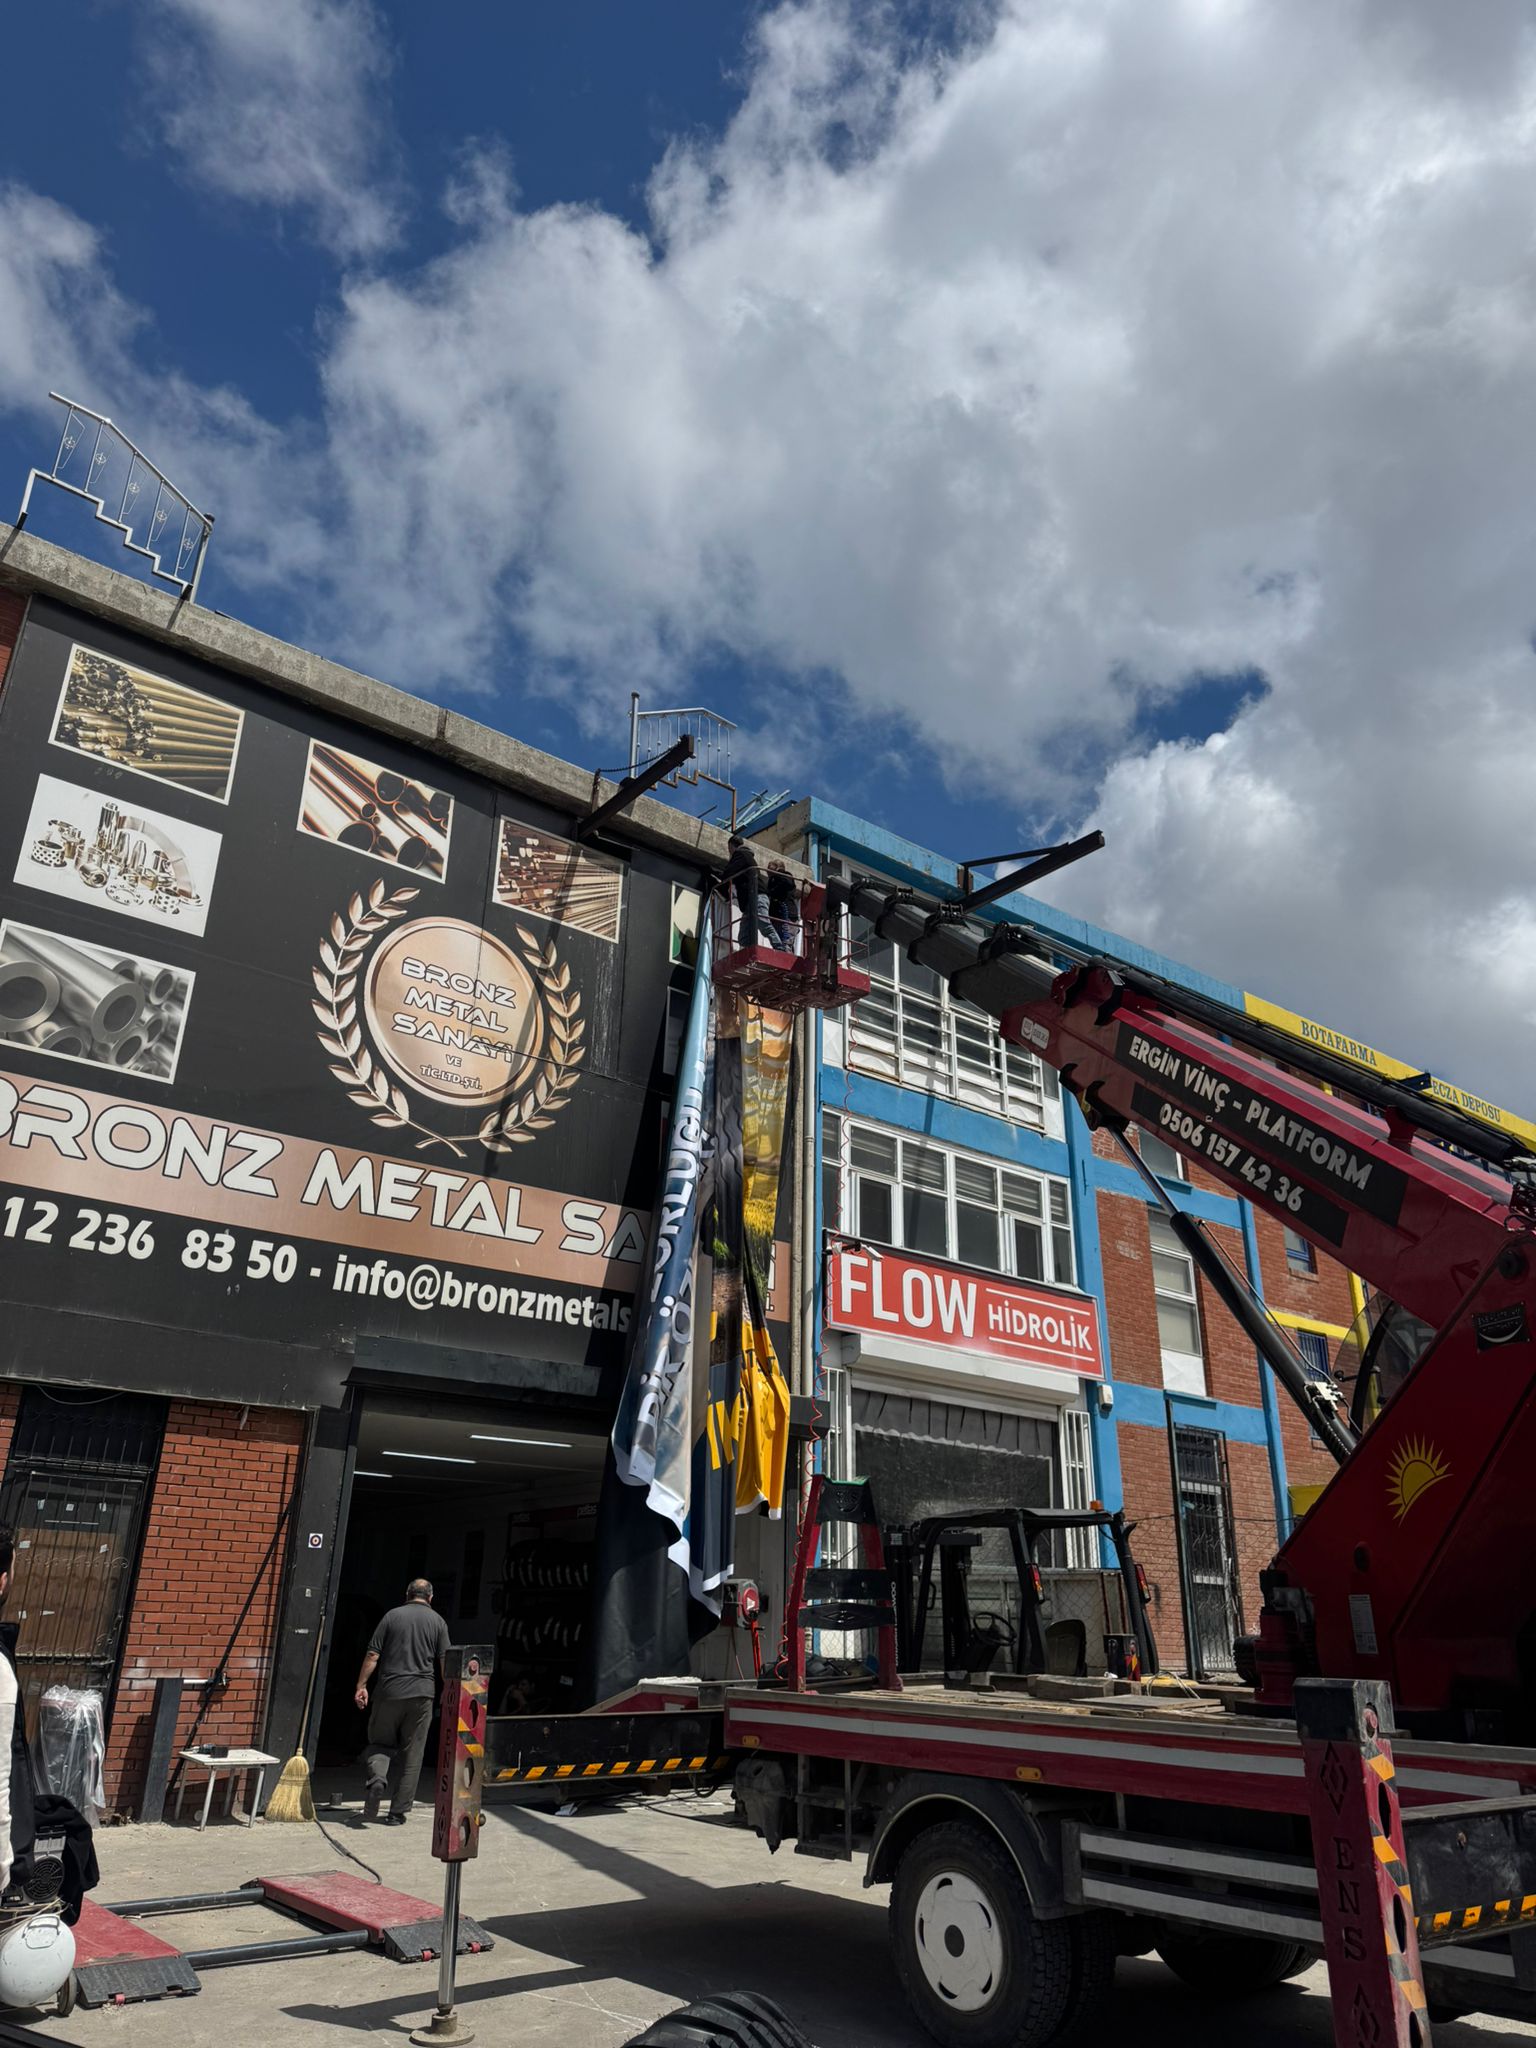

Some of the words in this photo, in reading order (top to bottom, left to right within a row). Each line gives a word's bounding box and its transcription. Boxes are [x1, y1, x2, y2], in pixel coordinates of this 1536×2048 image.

[401, 957, 516, 1009] BRONZ
[404, 986, 508, 1033] METAL
[446, 1054, 462, 1068] VE
[1300, 1019, 1378, 1067] BOTAFARMA
[1431, 1079, 1459, 1105] ECZA
[1460, 1092, 1501, 1123] DEPOSU
[0, 1077, 285, 1197] RONZ
[301, 1147, 545, 1246] METAL
[1128, 1034, 1181, 1081] ERGİN
[1185, 1065, 1231, 1113] VİNÇ
[1244, 1098, 1374, 1191] PLATFORM
[1159, 1102, 1204, 1148] 0506
[1206, 1133, 1241, 1168] 157
[1239, 1155, 1272, 1192] 42
[1273, 1175, 1305, 1212] 36
[3, 1196, 60, 1244] 12
[68, 1208, 156, 1260] 236
[181, 1228, 237, 1273] 83
[246, 1239, 299, 1283] 50
[840, 1252, 978, 1338] FLOW
[987, 1299, 1093, 1351] HİDROLİK
